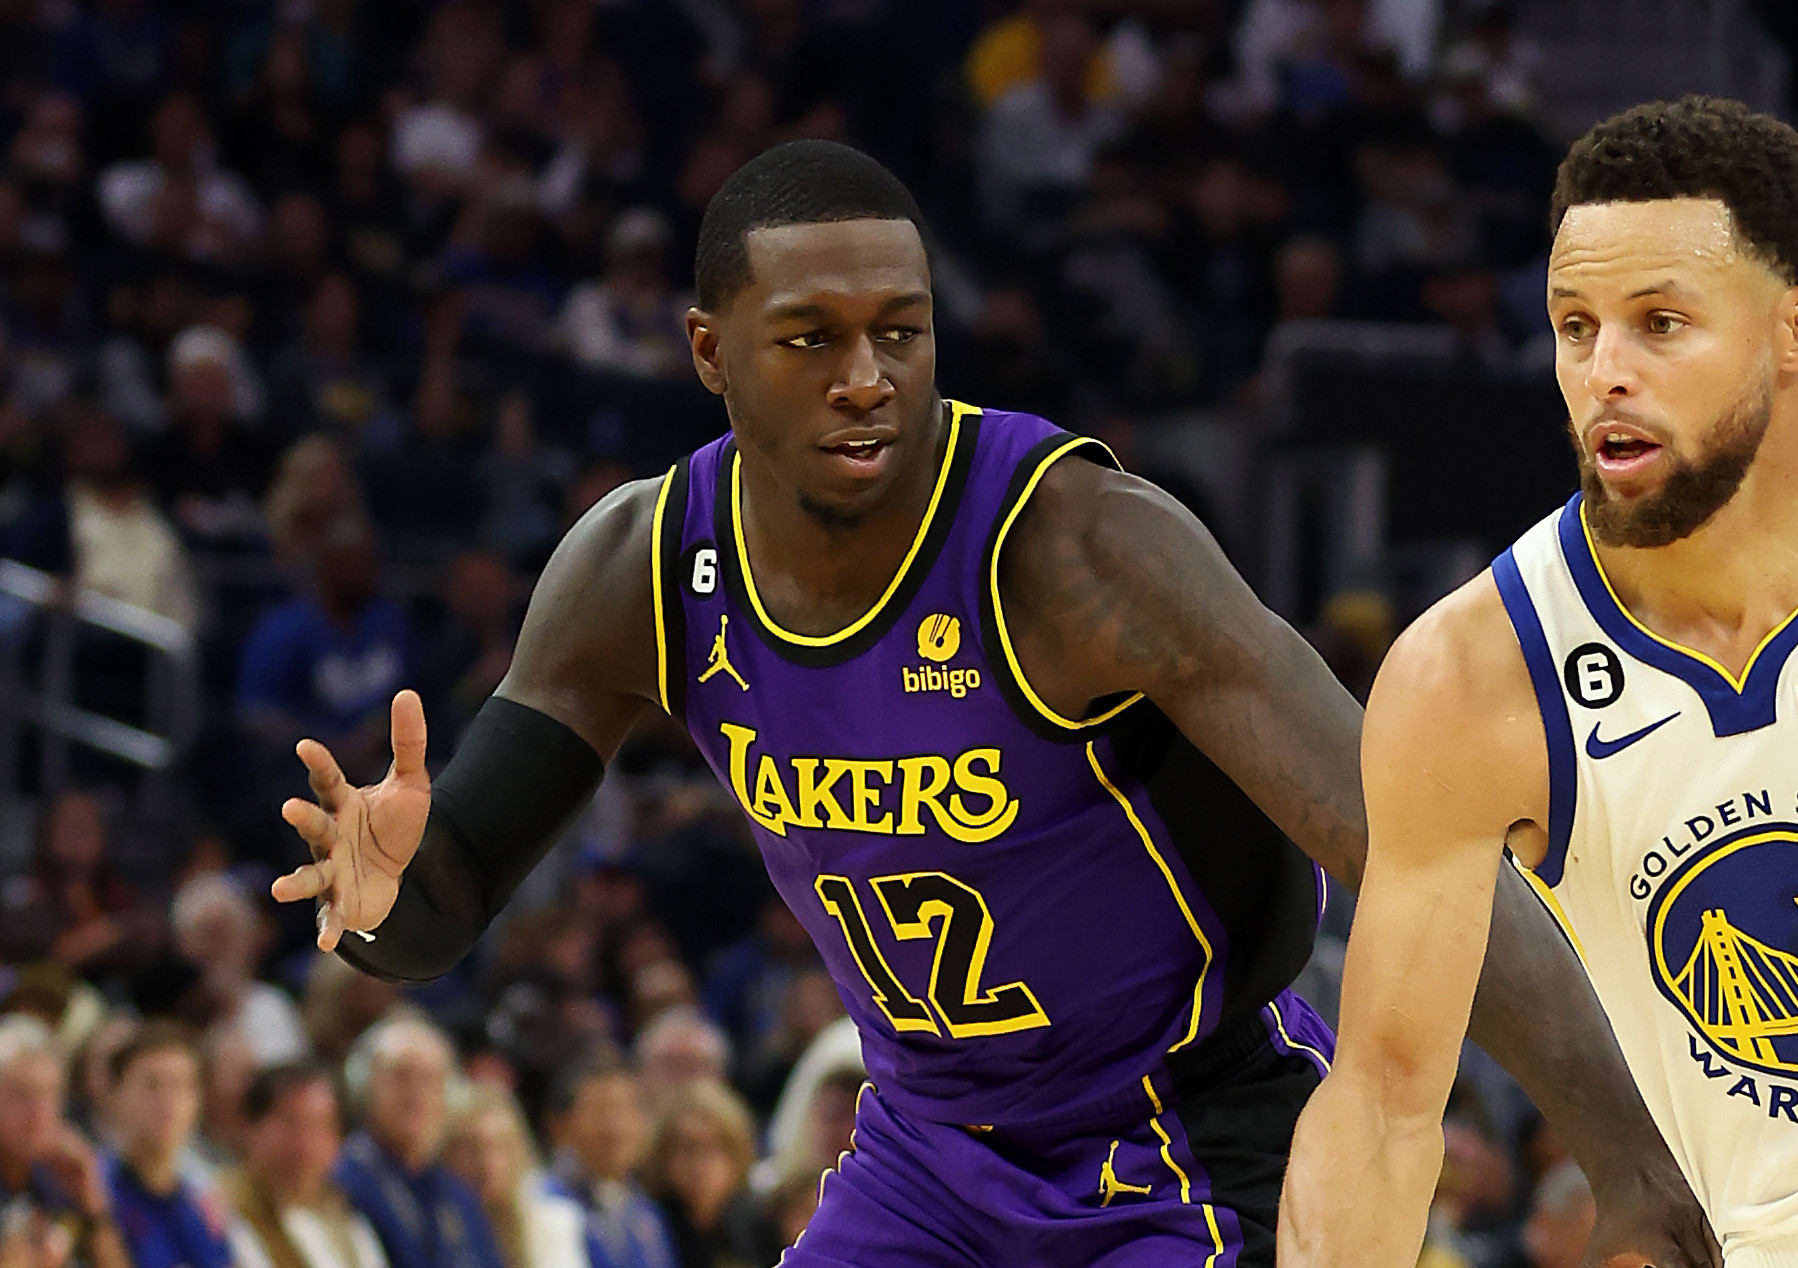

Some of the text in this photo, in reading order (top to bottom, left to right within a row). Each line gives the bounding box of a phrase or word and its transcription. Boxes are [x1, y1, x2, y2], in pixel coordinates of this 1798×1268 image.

[692, 549, 717, 593] 6
[902, 666, 981, 698] bibigo
[1576, 652, 1614, 701] 6
[719, 722, 1020, 844] LAKERS
[1630, 789, 1773, 901] GOLDEN
[814, 871, 1051, 1039] 12
